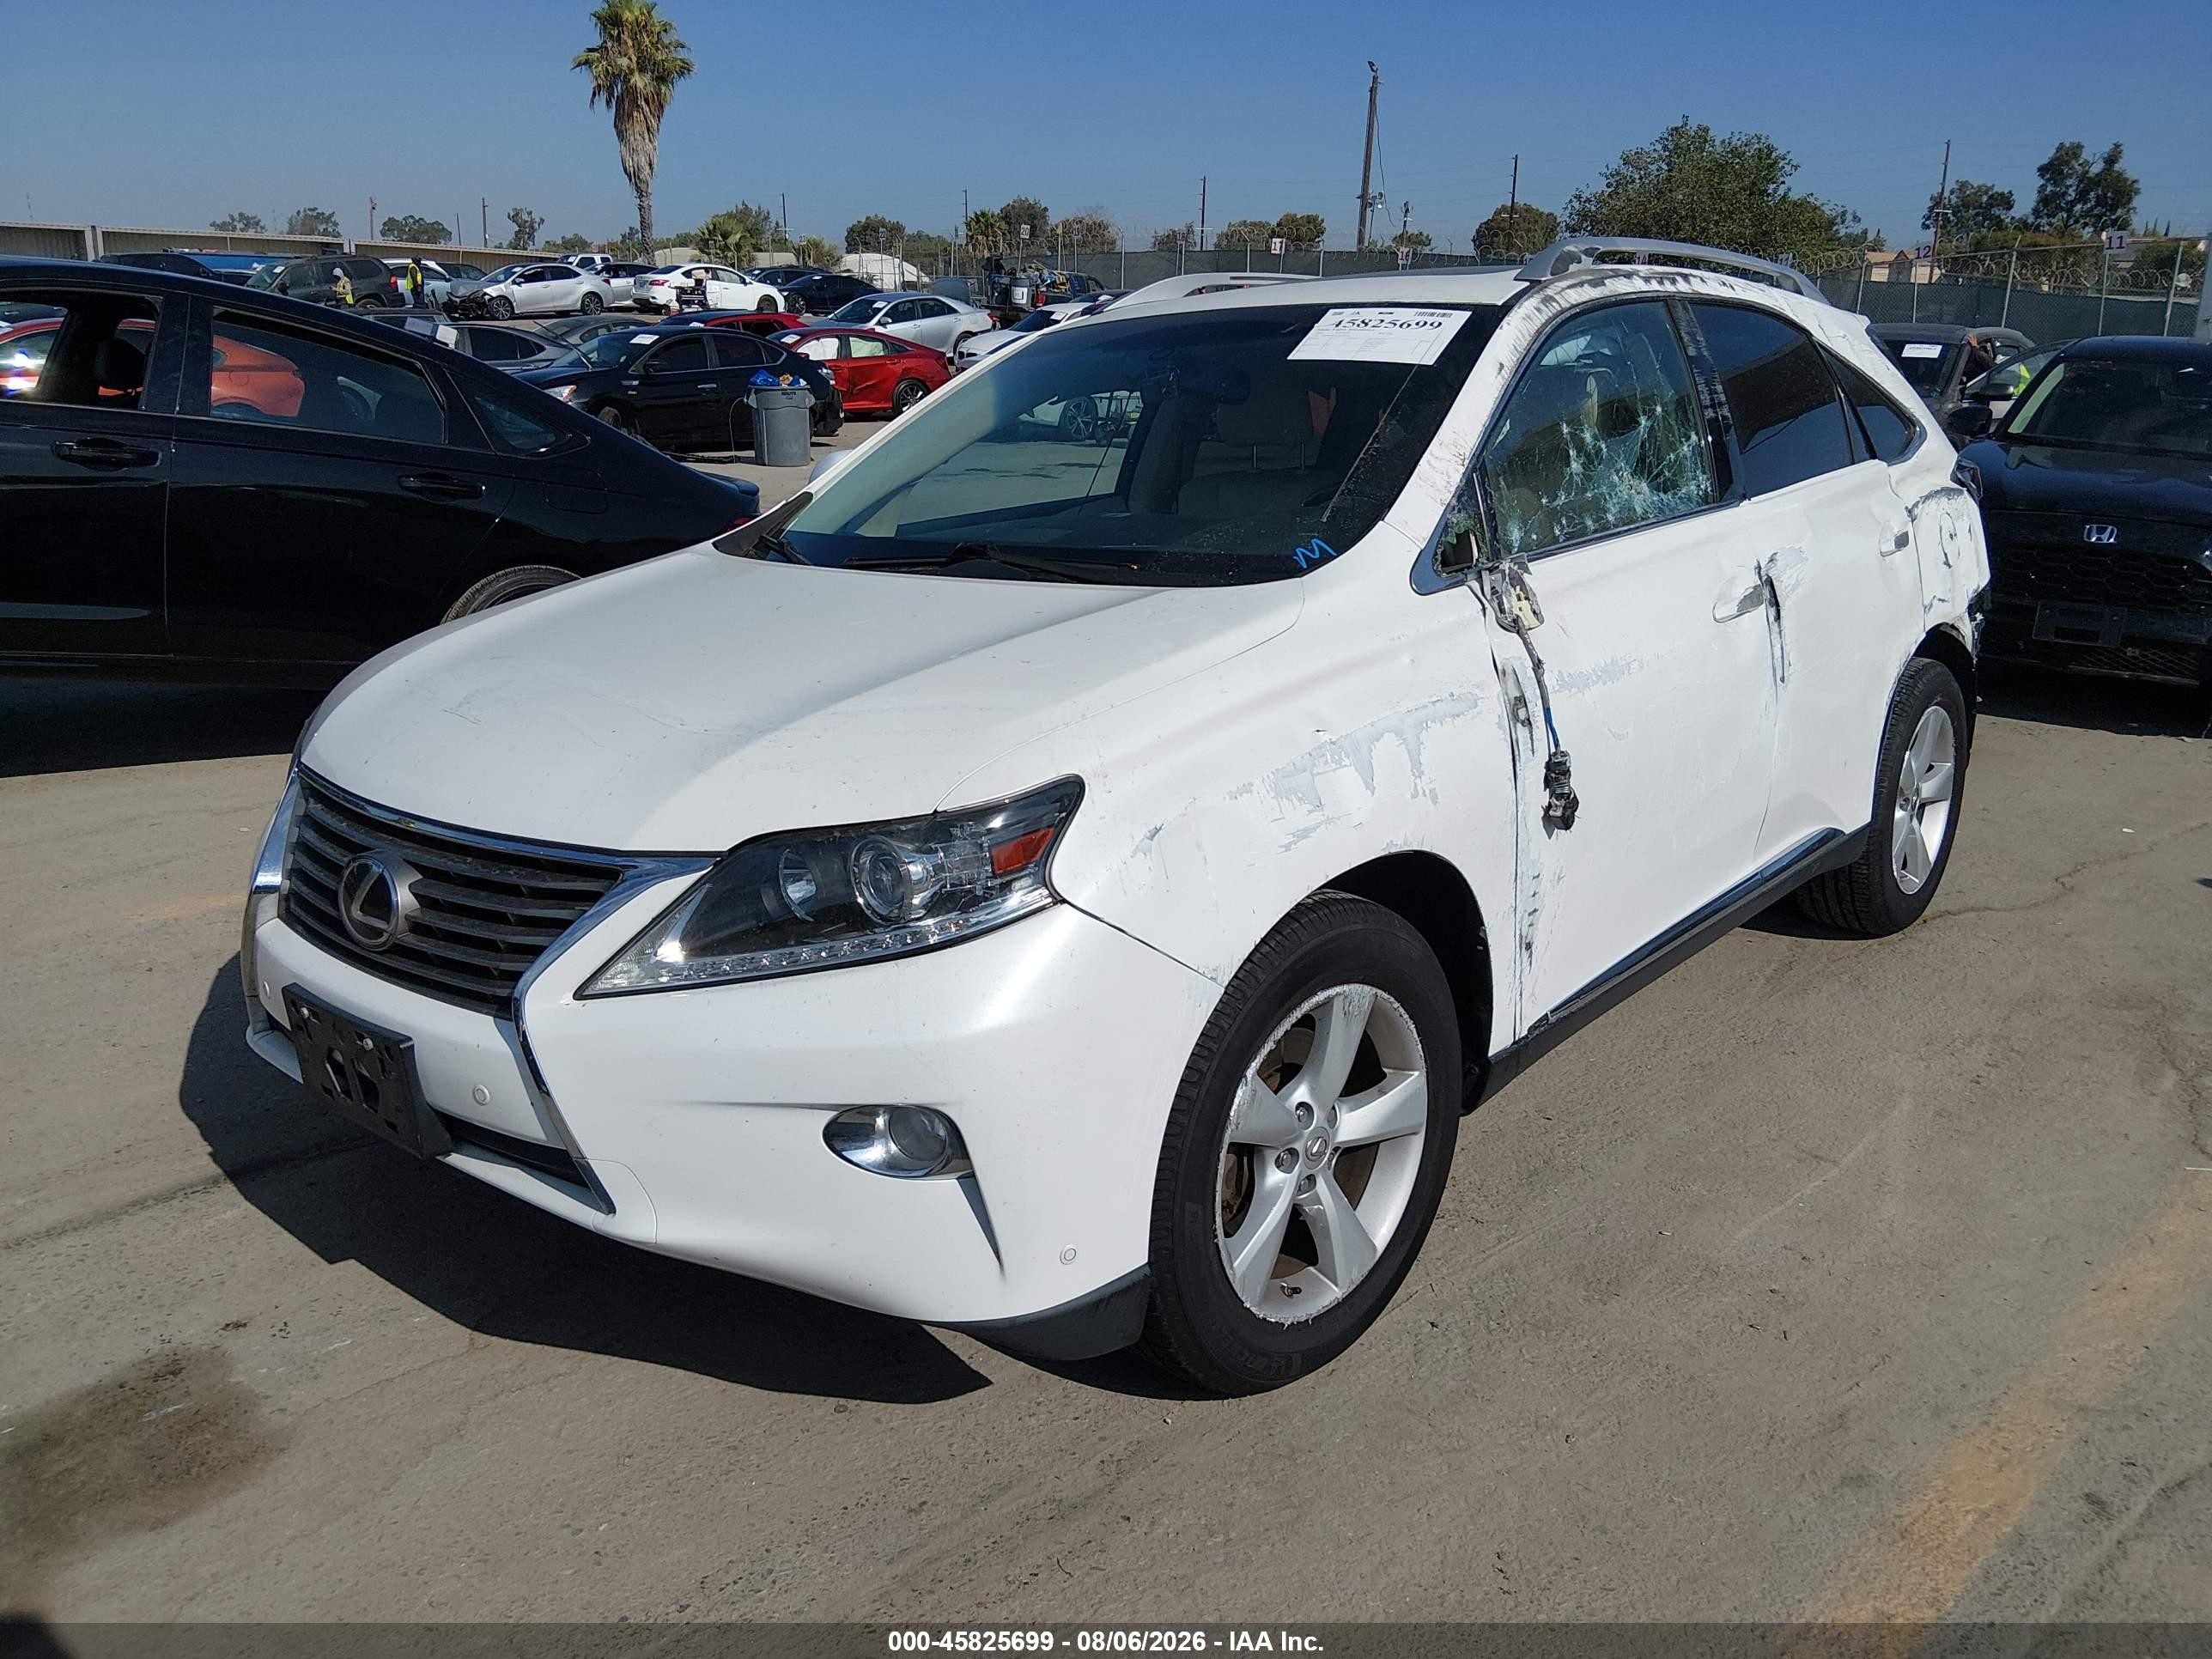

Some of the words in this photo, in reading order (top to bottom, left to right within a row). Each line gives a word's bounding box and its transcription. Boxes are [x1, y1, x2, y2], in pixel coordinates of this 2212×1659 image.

[1021, 227, 1030, 236] 20
[2106, 235, 2124, 250] 11
[1915, 245, 1931, 259] 12
